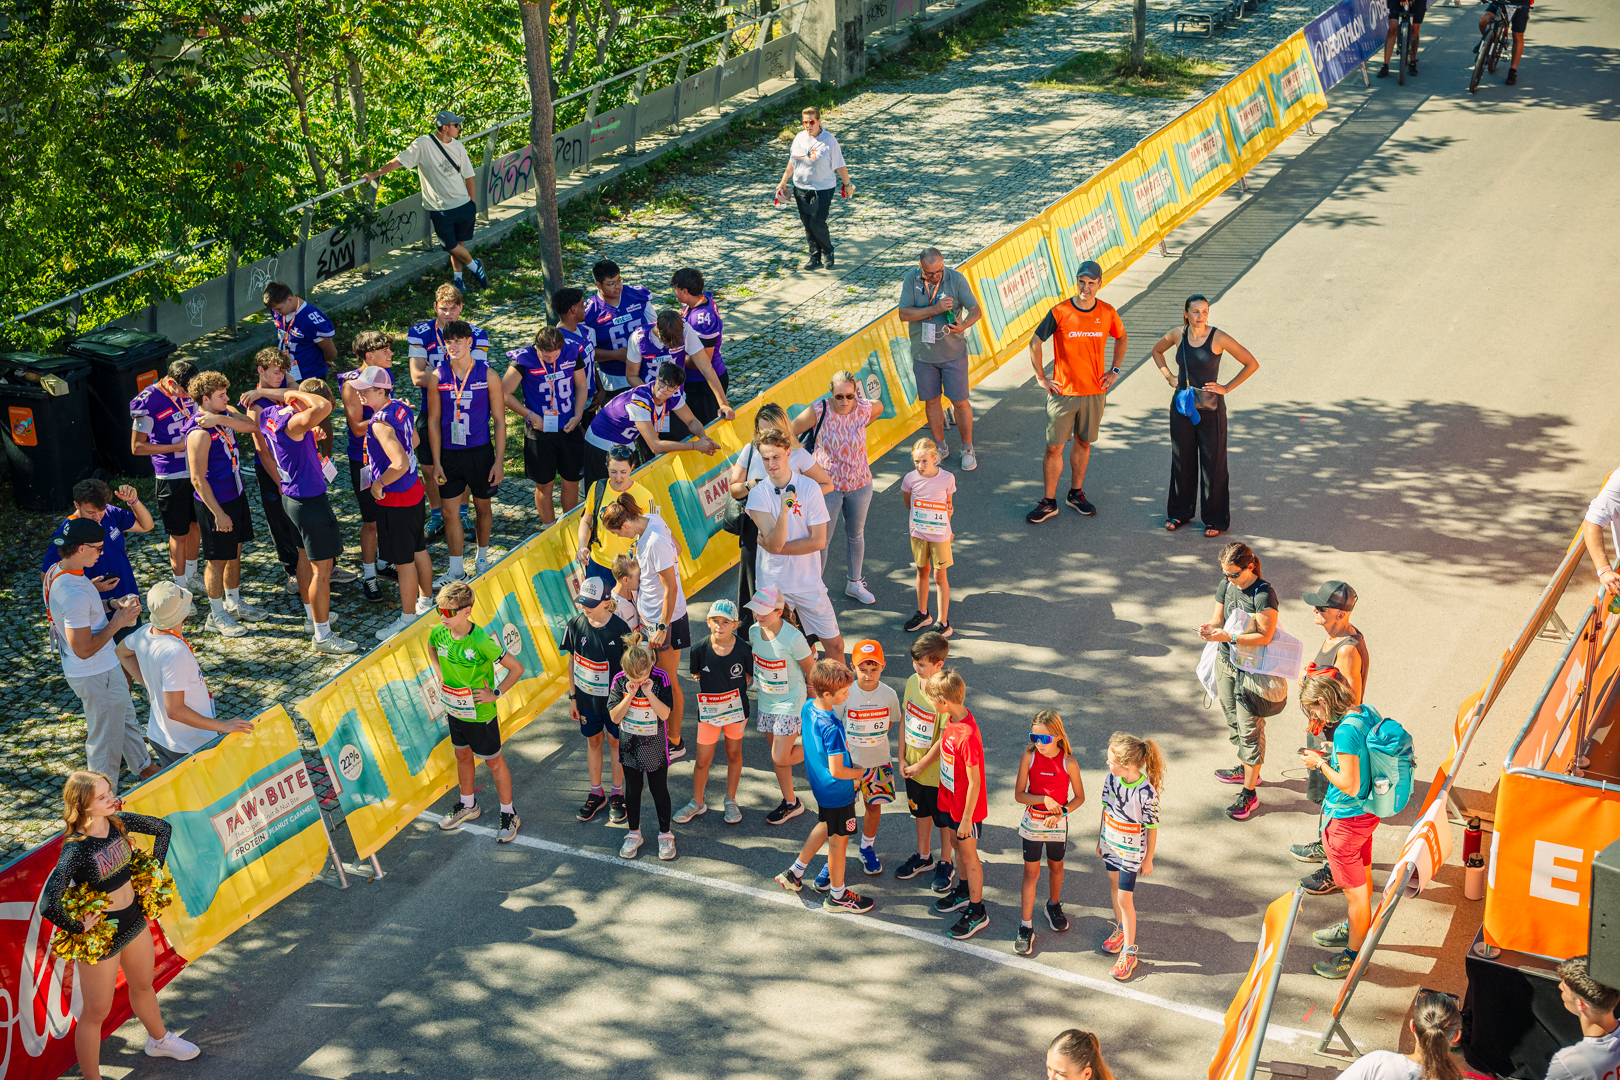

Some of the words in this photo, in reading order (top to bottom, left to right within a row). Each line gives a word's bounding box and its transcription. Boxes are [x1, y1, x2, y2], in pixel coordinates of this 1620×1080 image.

[1323, 14, 1366, 62] DECATHLON
[307, 311, 326, 325] 95
[697, 311, 712, 325] 54
[867, 378, 880, 392] 22%
[538, 376, 572, 415] 39
[714, 602, 733, 615] TAKE
[504, 628, 519, 646] 22%
[772, 672, 778, 680] 3
[644, 711, 650, 719] 2
[873, 721, 884, 730] 62
[916, 723, 927, 733] 40
[340, 750, 360, 771] 22%
[234, 831, 245, 840] The
[244, 818, 264, 834] Organic
[279, 802, 291, 811] Nut
[290, 796, 300, 805] Bite
[234, 832, 266, 858] PROTEIN
[268, 819, 289, 836] PEANUT
[289, 804, 315, 822] CARAMEL
[1122, 836, 1133, 845] 12
